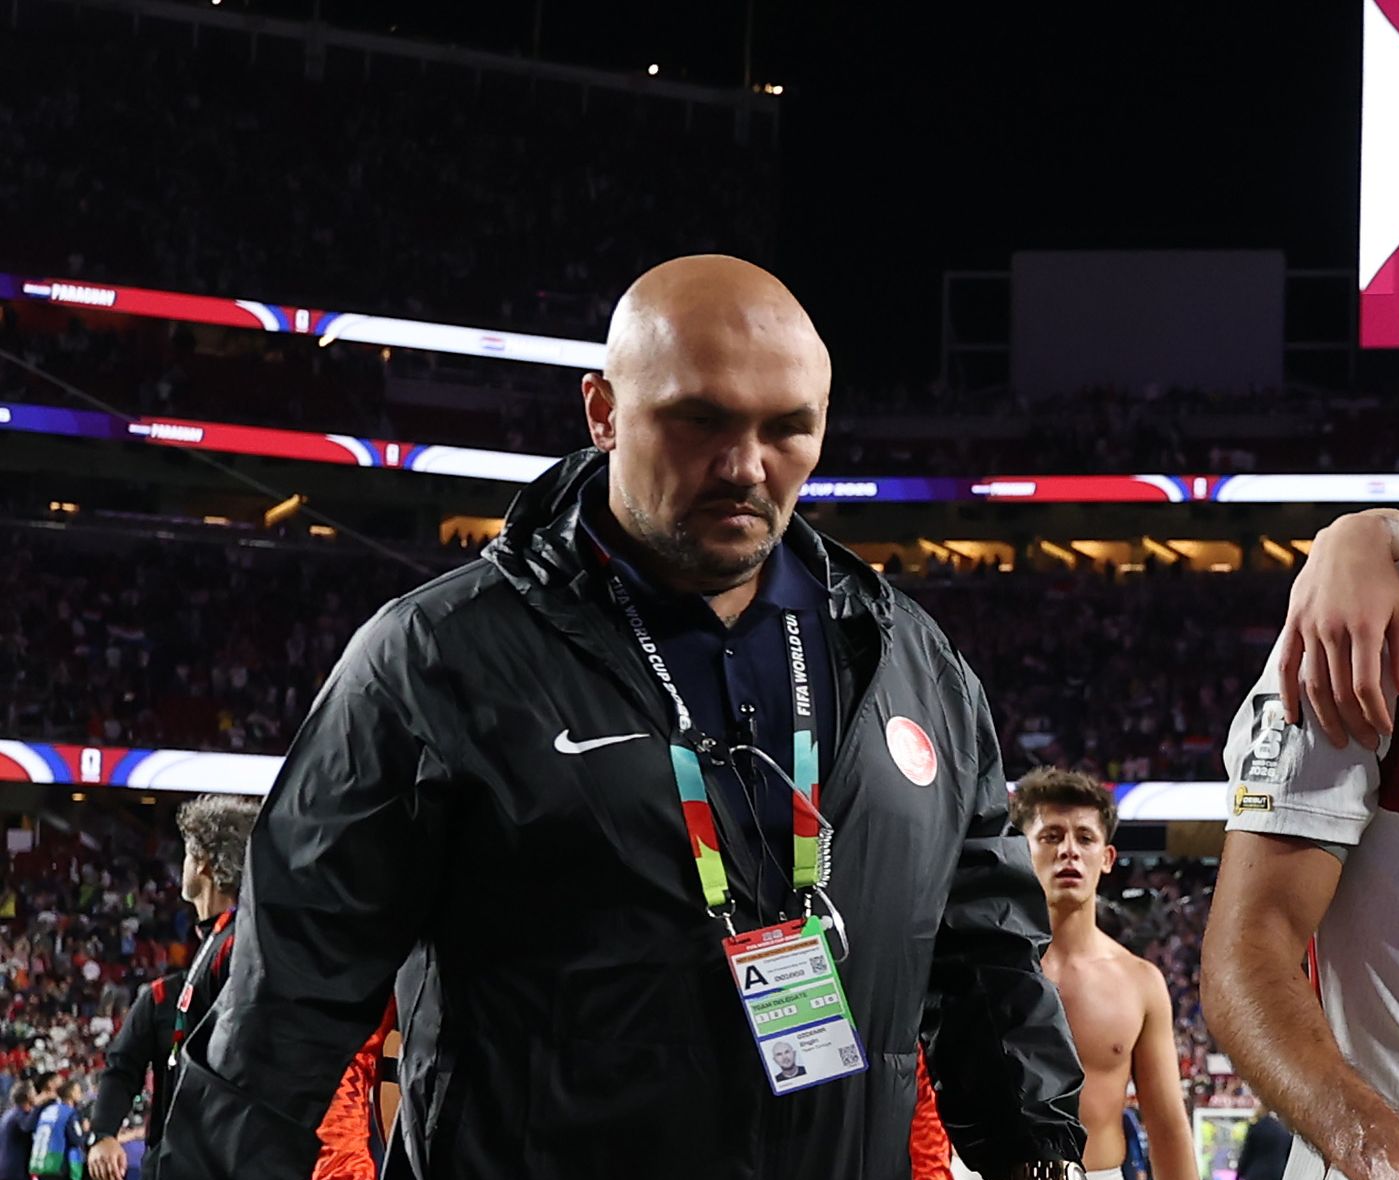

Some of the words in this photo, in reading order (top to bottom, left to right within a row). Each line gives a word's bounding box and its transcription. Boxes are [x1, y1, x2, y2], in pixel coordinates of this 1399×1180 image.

[648, 653, 671, 682] CUP
[788, 635, 809, 683] WORLD
[795, 685, 812, 717] FIFA
[744, 964, 769, 990] A
